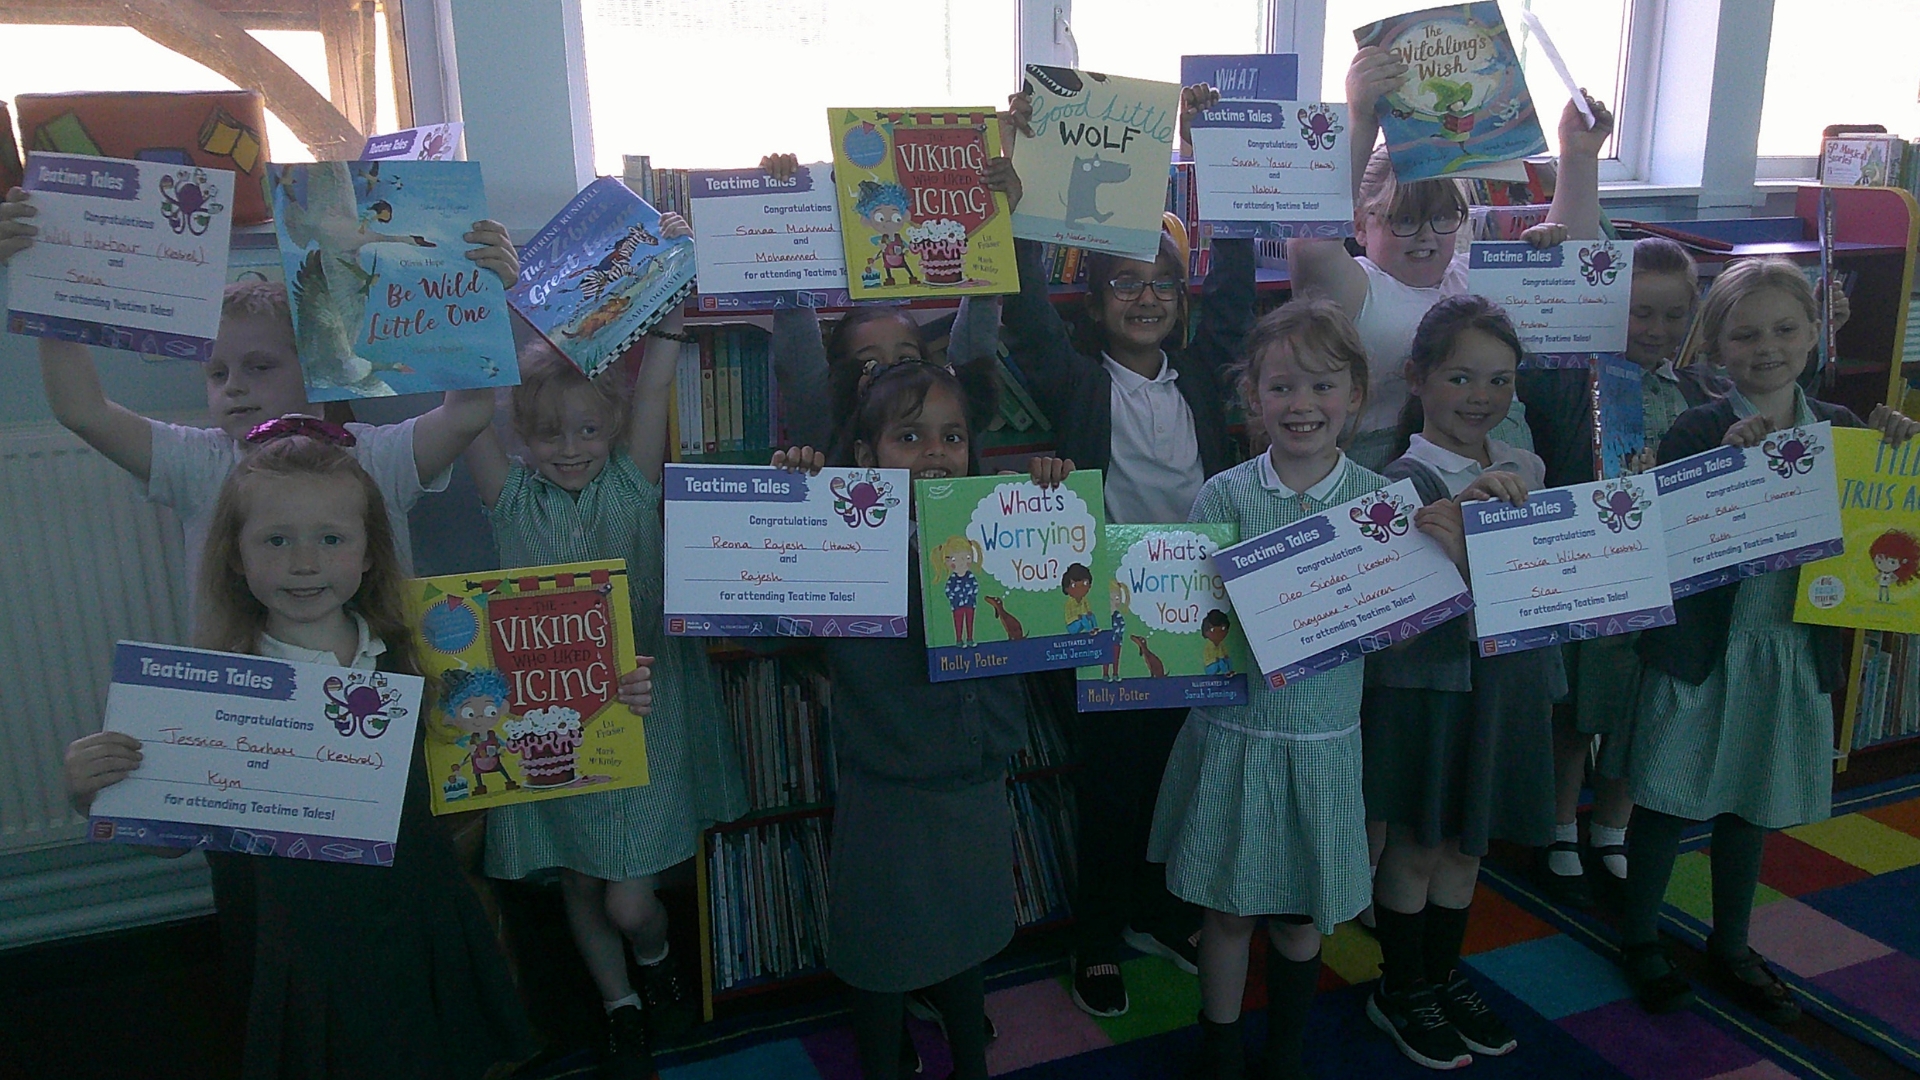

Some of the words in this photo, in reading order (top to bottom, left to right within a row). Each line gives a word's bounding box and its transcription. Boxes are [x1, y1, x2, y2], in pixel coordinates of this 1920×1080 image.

[1422, 25, 1443, 38] The
[1390, 34, 1488, 64] Witchling's
[1414, 56, 1467, 81] Wish
[1215, 68, 1258, 90] WHAT
[1097, 94, 1174, 143] Little
[1202, 109, 1245, 122] Teatime
[1247, 110, 1273, 123] Tales
[369, 141, 392, 154] Teatime
[392, 139, 409, 151] Tales
[1060, 121, 1141, 153] WOLF
[1247, 139, 1298, 149] Congratulations
[897, 143, 984, 175] VIKING
[38, 166, 86, 185] Teatime
[91, 171, 124, 190] Tales
[706, 177, 759, 190] Teatime
[913, 175, 938, 185] WHO
[944, 174, 972, 184] LIKED
[764, 204, 832, 215] Congratulations
[912, 187, 987, 219] ICING
[1244, 201, 1274, 211] attending
[1276, 201, 1300, 209] Teatime
[1302, 202, 1319, 210] Tales!
[84, 210, 154, 229] Congratulations
[518, 224, 560, 266] ATHERINE
[560, 188, 600, 226] RUNDELL
[793, 237, 809, 245] and
[107, 258, 123, 267] and
[426, 258, 444, 267] Hope
[1482, 250, 1523, 262] Teatime
[1526, 251, 1552, 262] Tales
[521, 258, 547, 282] The
[529, 253, 580, 306] Great
[744, 271, 757, 279] for
[760, 269, 801, 279] attending
[1522, 278, 1576, 287] Congratulations
[54, 291, 68, 301] for
[69, 294, 110, 310] attending
[113, 299, 147, 313] Teatime
[150, 305, 174, 317] Tales!
[387, 283, 416, 308] Be
[626, 303, 650, 324] SARA
[367, 309, 439, 344] Little
[444, 304, 490, 326] One
[1518, 335, 1544, 344] tending
[1545, 334, 1571, 342] Teatime
[1573, 334, 1591, 342] Tales!
[1658, 466, 1703, 488] Teatime
[1704, 455, 1733, 473] Tales
[685, 476, 747, 493] Teatime
[752, 478, 790, 494] Tales
[1706, 476, 1766, 499] Congratulations
[999, 489, 1065, 516] What's
[749, 515, 828, 527] Congratulations
[1478, 506, 1528, 525] Teatime
[1530, 501, 1561, 516] Tales
[1732, 512, 1746, 522] and
[764, 538, 807, 554] Rajesh
[980, 521, 1086, 556] Worrying
[1533, 528, 1596, 546] Congratulations
[1693, 553, 1705, 564] for
[1706, 543, 1742, 561] attending
[1743, 536, 1774, 550] Teatime
[1775, 529, 1798, 544] Tales!
[779, 554, 797, 563] and
[1147, 539, 1207, 562] What's
[1232, 539, 1286, 570] Teatime
[1285, 527, 1321, 547] Tales
[1011, 558, 1059, 582] You?
[1296, 544, 1363, 576] Congratulations
[741, 570, 783, 585] Rajesh
[1562, 566, 1577, 575] and
[1129, 567, 1225, 600] Worrying
[1336, 583, 1352, 595] and
[533, 601, 557, 612] THE
[720, 591, 735, 601] for
[737, 591, 785, 603] attending
[788, 592, 826, 602] Teatime
[829, 592, 856, 602] Tales!
[1519, 608, 1532, 618] for
[1534, 602, 1573, 615] attending
[1574, 596, 1606, 608] Teatime
[1607, 591, 1629, 603] Tales!
[1156, 602, 1199, 624] You?
[1300, 635, 1315, 646] for
[1316, 618, 1356, 640] attending
[1357, 604, 1391, 623] Teatime
[1391, 593, 1417, 612] Tales!
[493, 608, 607, 653] VIKING
[1053, 639, 1086, 648] ILLUSTRATED
[512, 652, 546, 668] WHO
[553, 650, 591, 664] LIKED
[940, 655, 971, 673] Molly
[975, 652, 1008, 668] Potter
[1046, 649, 1068, 661] Sarah
[1070, 648, 1103, 660] Jennings
[140, 657, 219, 684] Teatime
[225, 667, 274, 691] Tales
[511, 662, 610, 707] ICING
[1185, 688, 1204, 699] Sarah
[1207, 688, 1237, 700] Jennings
[1088, 688, 1115, 705] Molly
[1119, 687, 1150, 701] Potter
[215, 709, 314, 732] Congratulations
[595, 726, 626, 739] Fraser
[595, 748, 616, 756] Mark
[246, 759, 269, 770] and
[164, 793, 185, 806] for
[187, 796, 247, 814] attending
[250, 801, 299, 817] Teatime
[303, 807, 336, 822] Tales!
